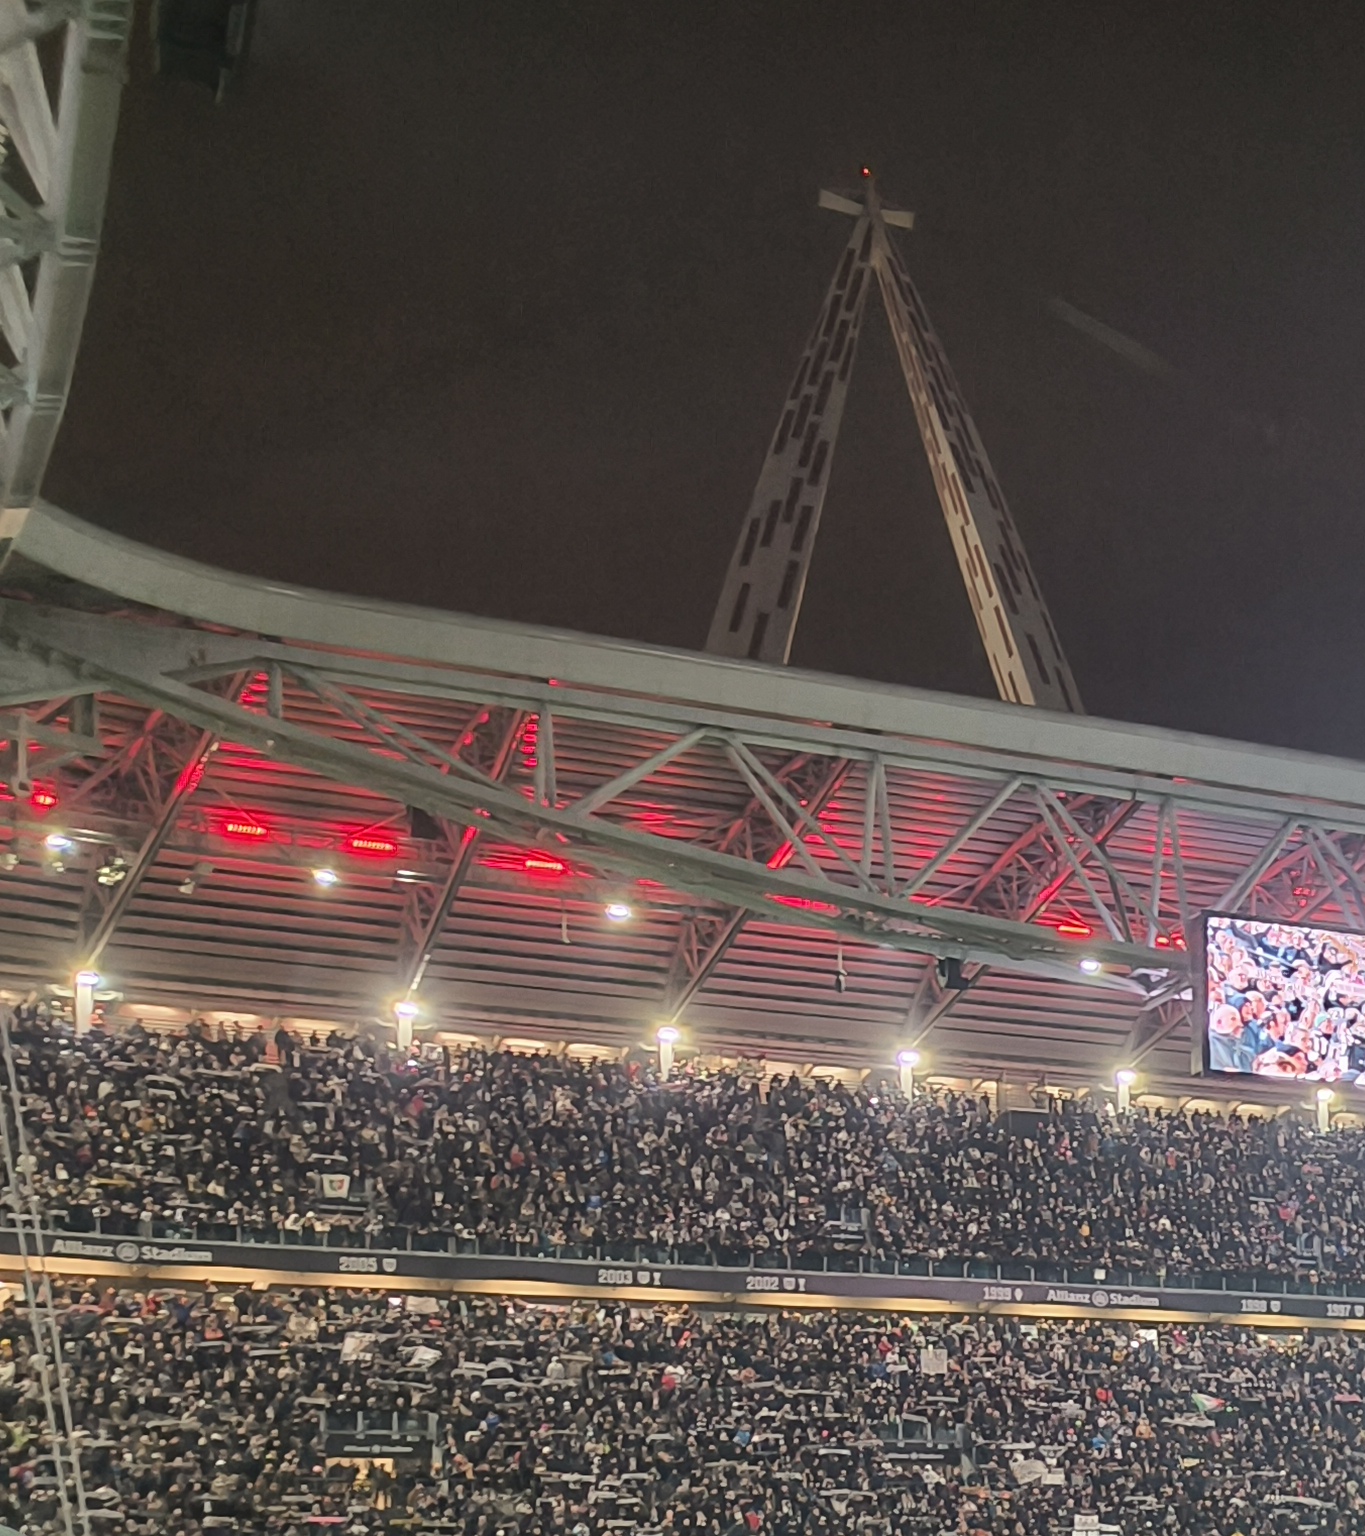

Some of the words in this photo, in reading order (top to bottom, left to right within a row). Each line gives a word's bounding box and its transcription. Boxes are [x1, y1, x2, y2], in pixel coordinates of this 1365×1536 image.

[52, 1239, 115, 1257] Allianz
[140, 1246, 213, 1262] Stadium
[598, 1269, 633, 1284] 2003
[746, 1276, 779, 1290] 2002
[1046, 1289, 1090, 1303] Allianz
[1110, 1293, 1159, 1307] Stadium
